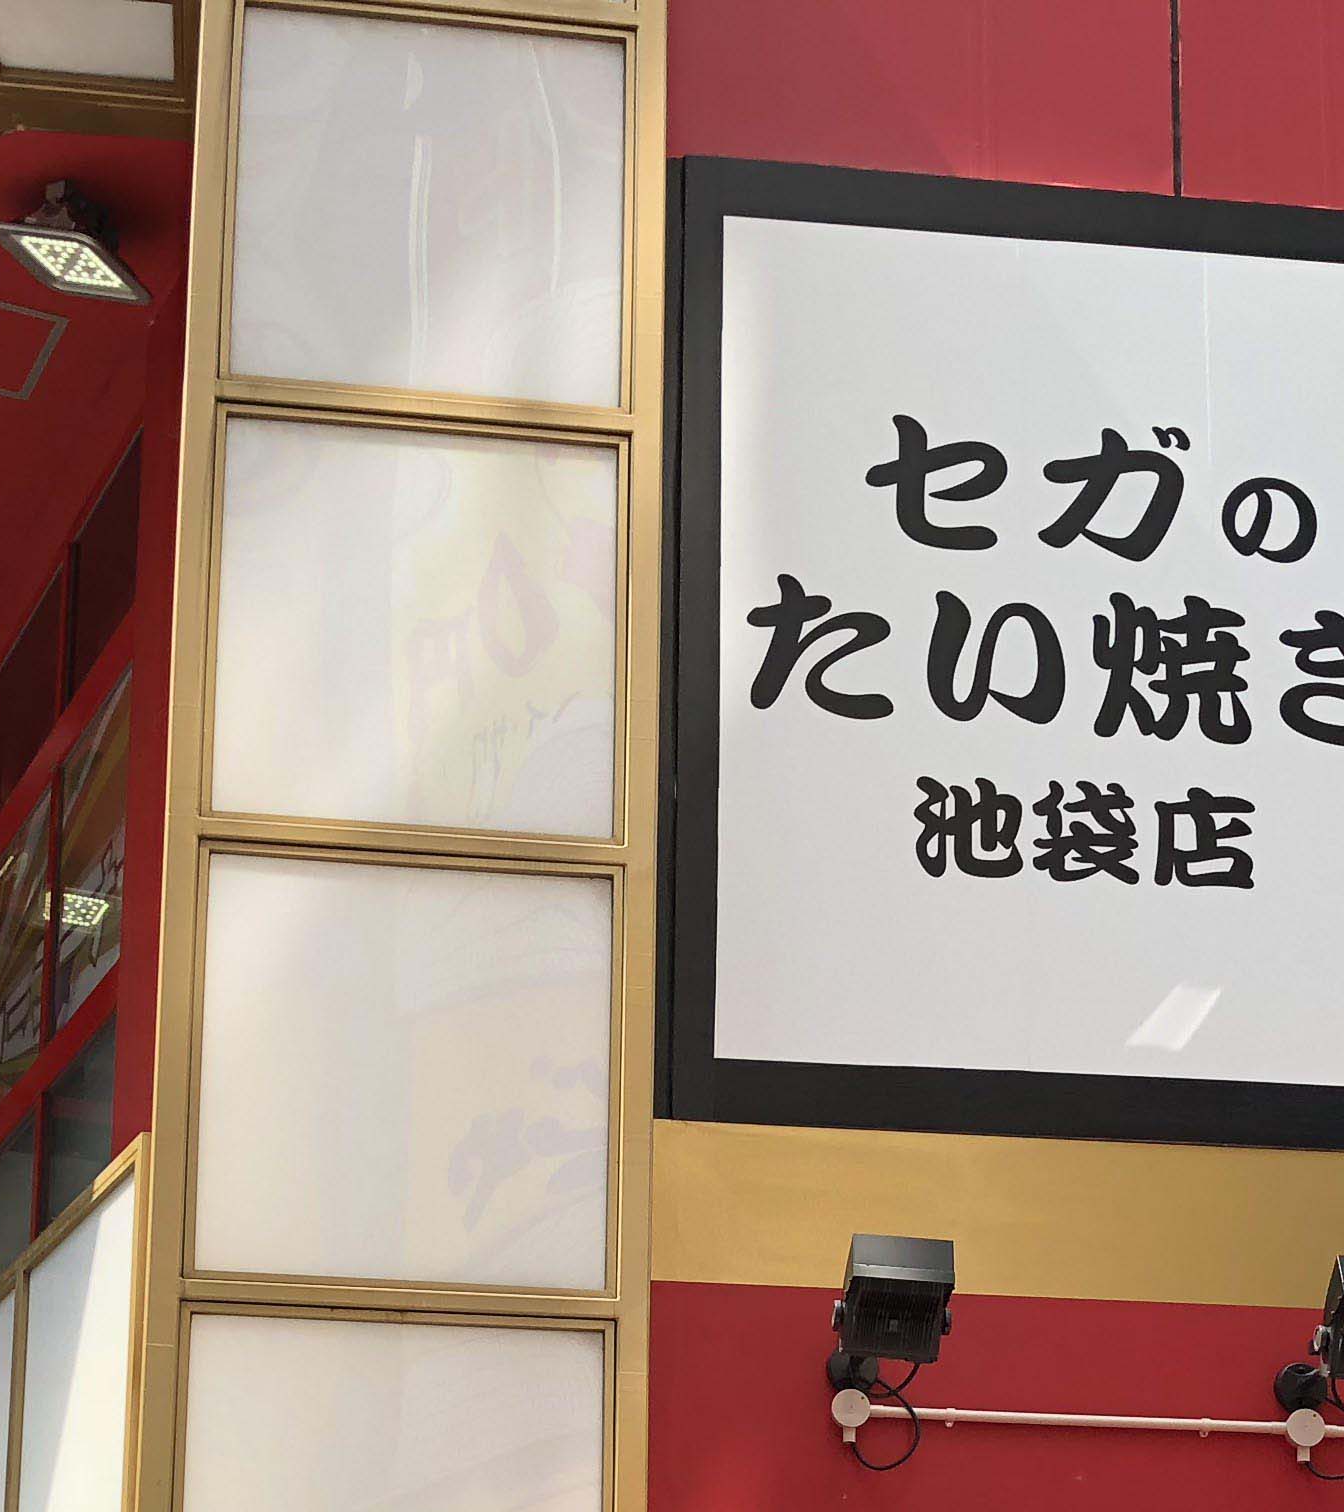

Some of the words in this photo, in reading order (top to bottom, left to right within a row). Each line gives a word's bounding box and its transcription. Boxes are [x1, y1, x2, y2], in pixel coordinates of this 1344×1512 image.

[866, 414, 1318, 563] セガの
[914, 776, 1255, 889] 池袋店
